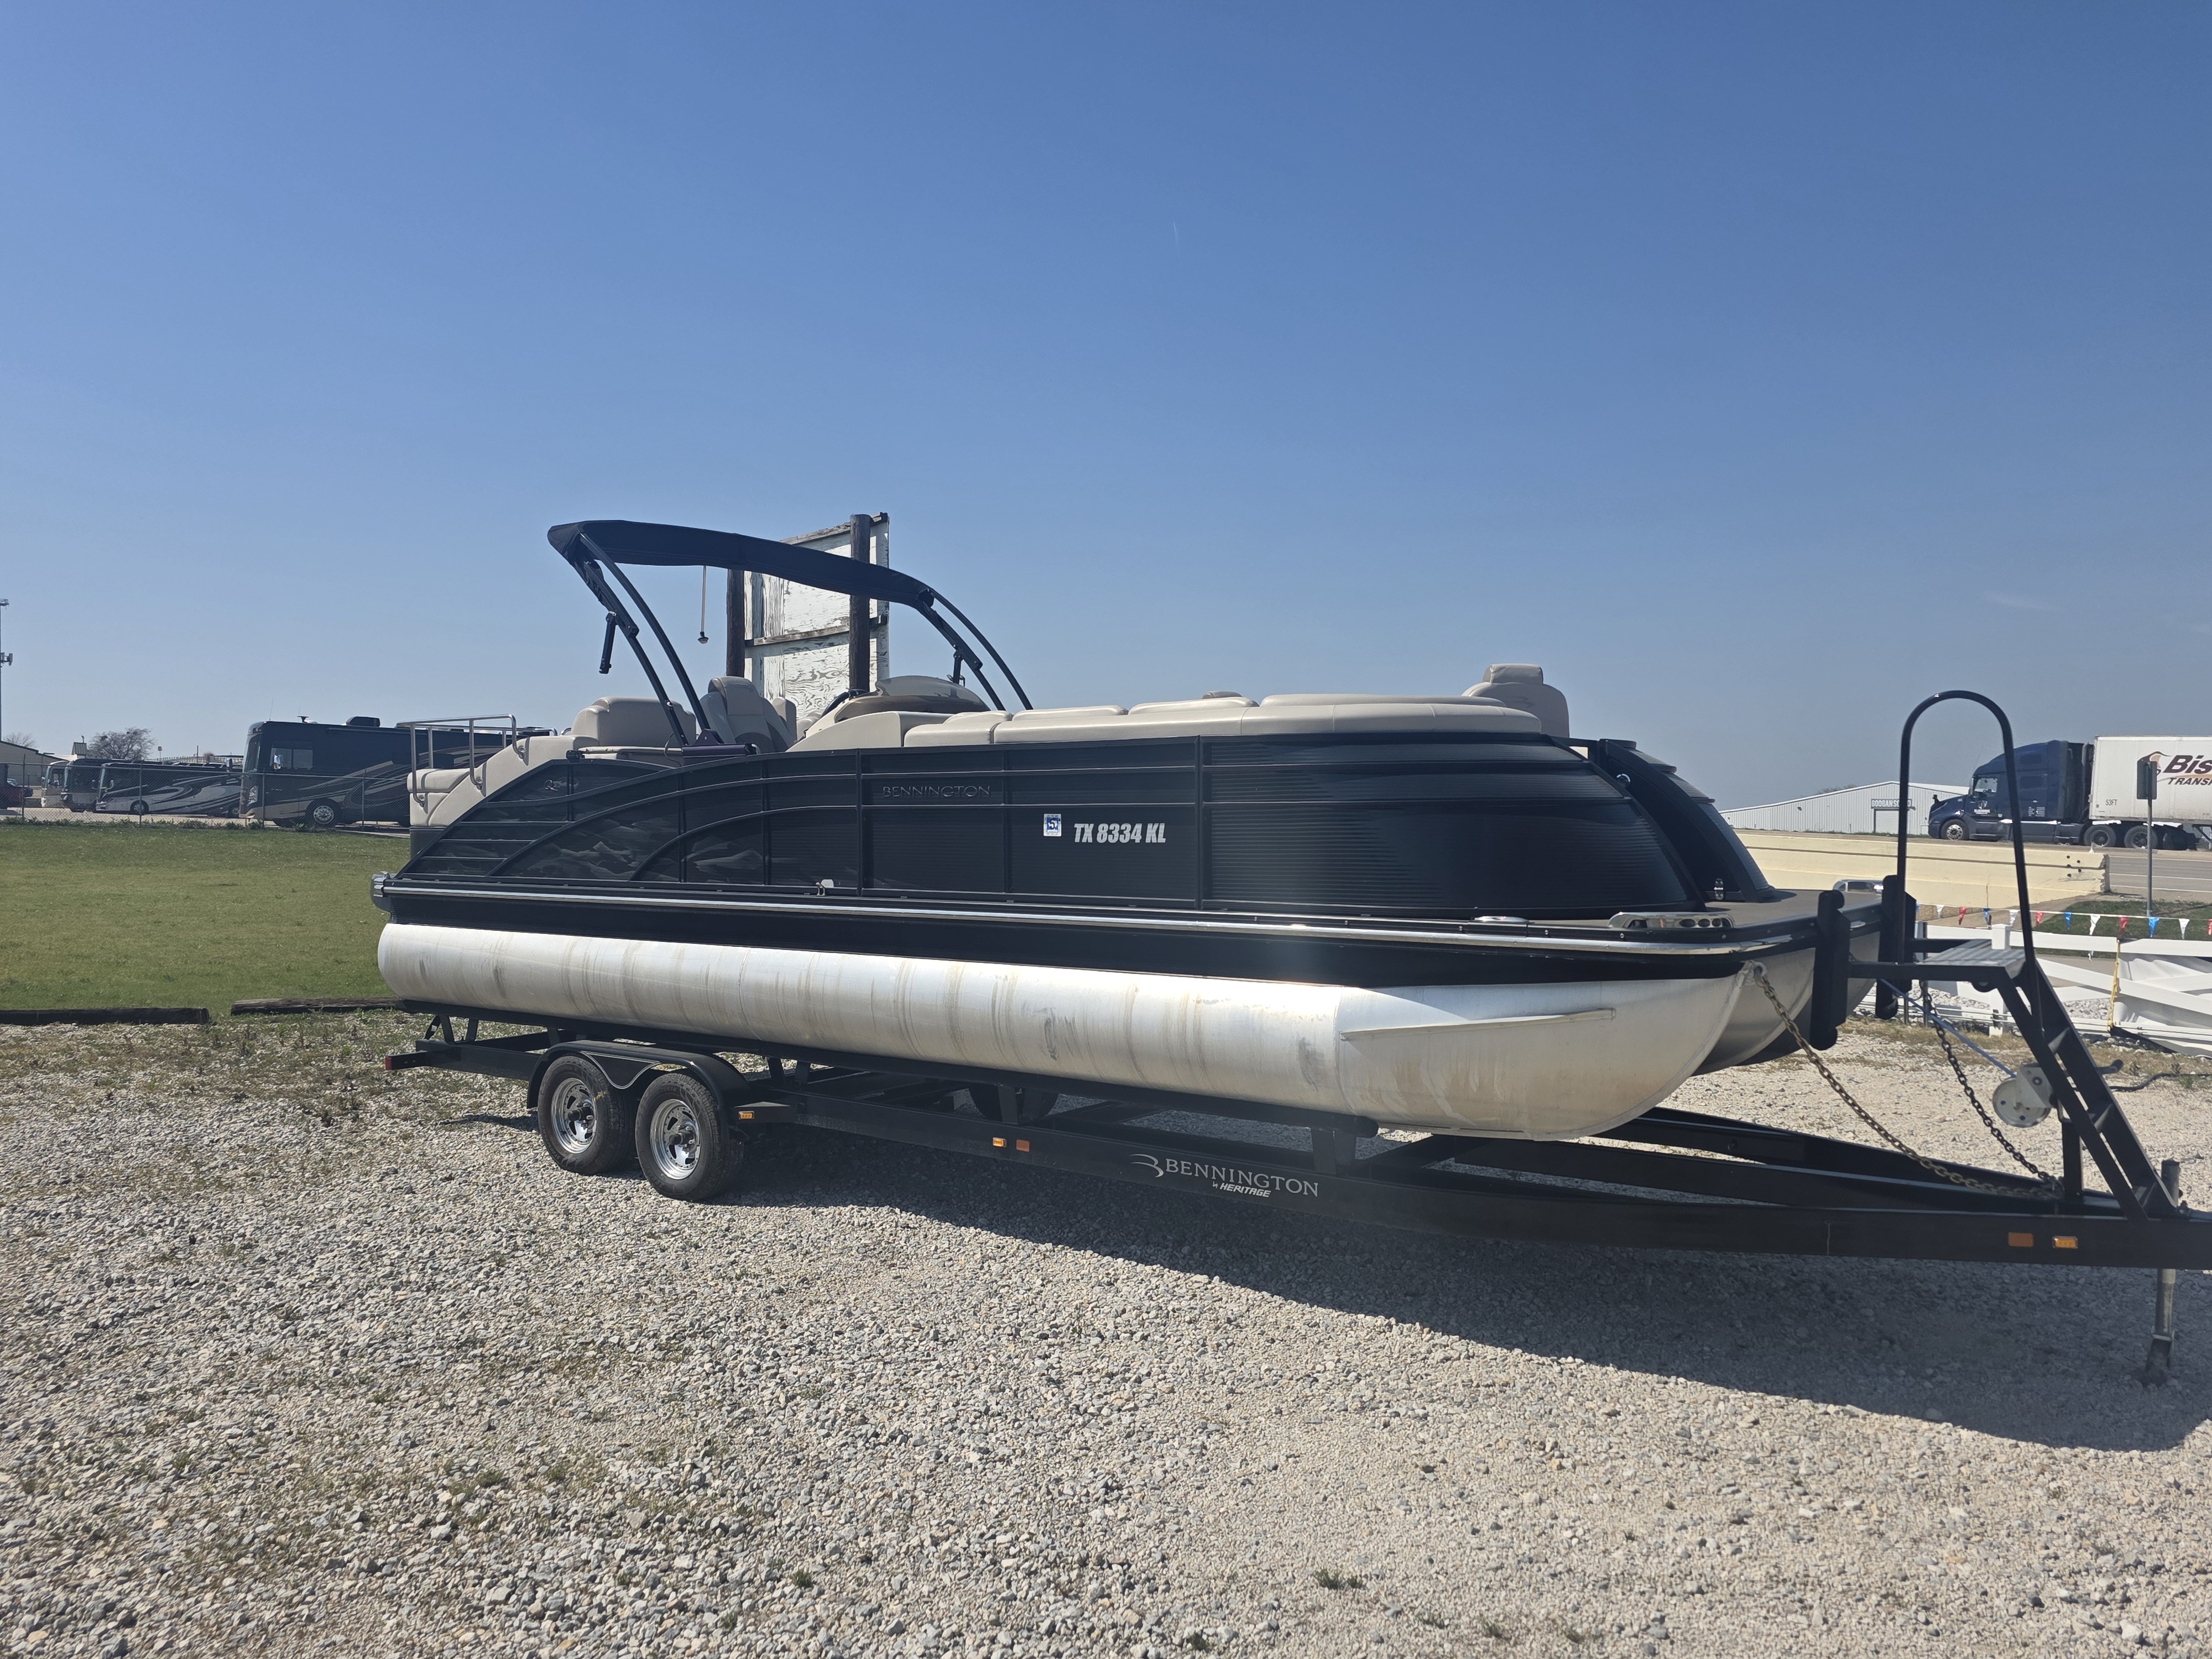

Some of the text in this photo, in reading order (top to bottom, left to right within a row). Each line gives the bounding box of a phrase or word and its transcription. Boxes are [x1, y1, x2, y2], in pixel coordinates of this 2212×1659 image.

[883, 785, 990, 797] BENNINGTON
[1074, 823, 1166, 843] TX 8334 KL
[1166, 1158, 1318, 1197] BENNINGTON
[1219, 1182, 1271, 1198] HERITAGE
